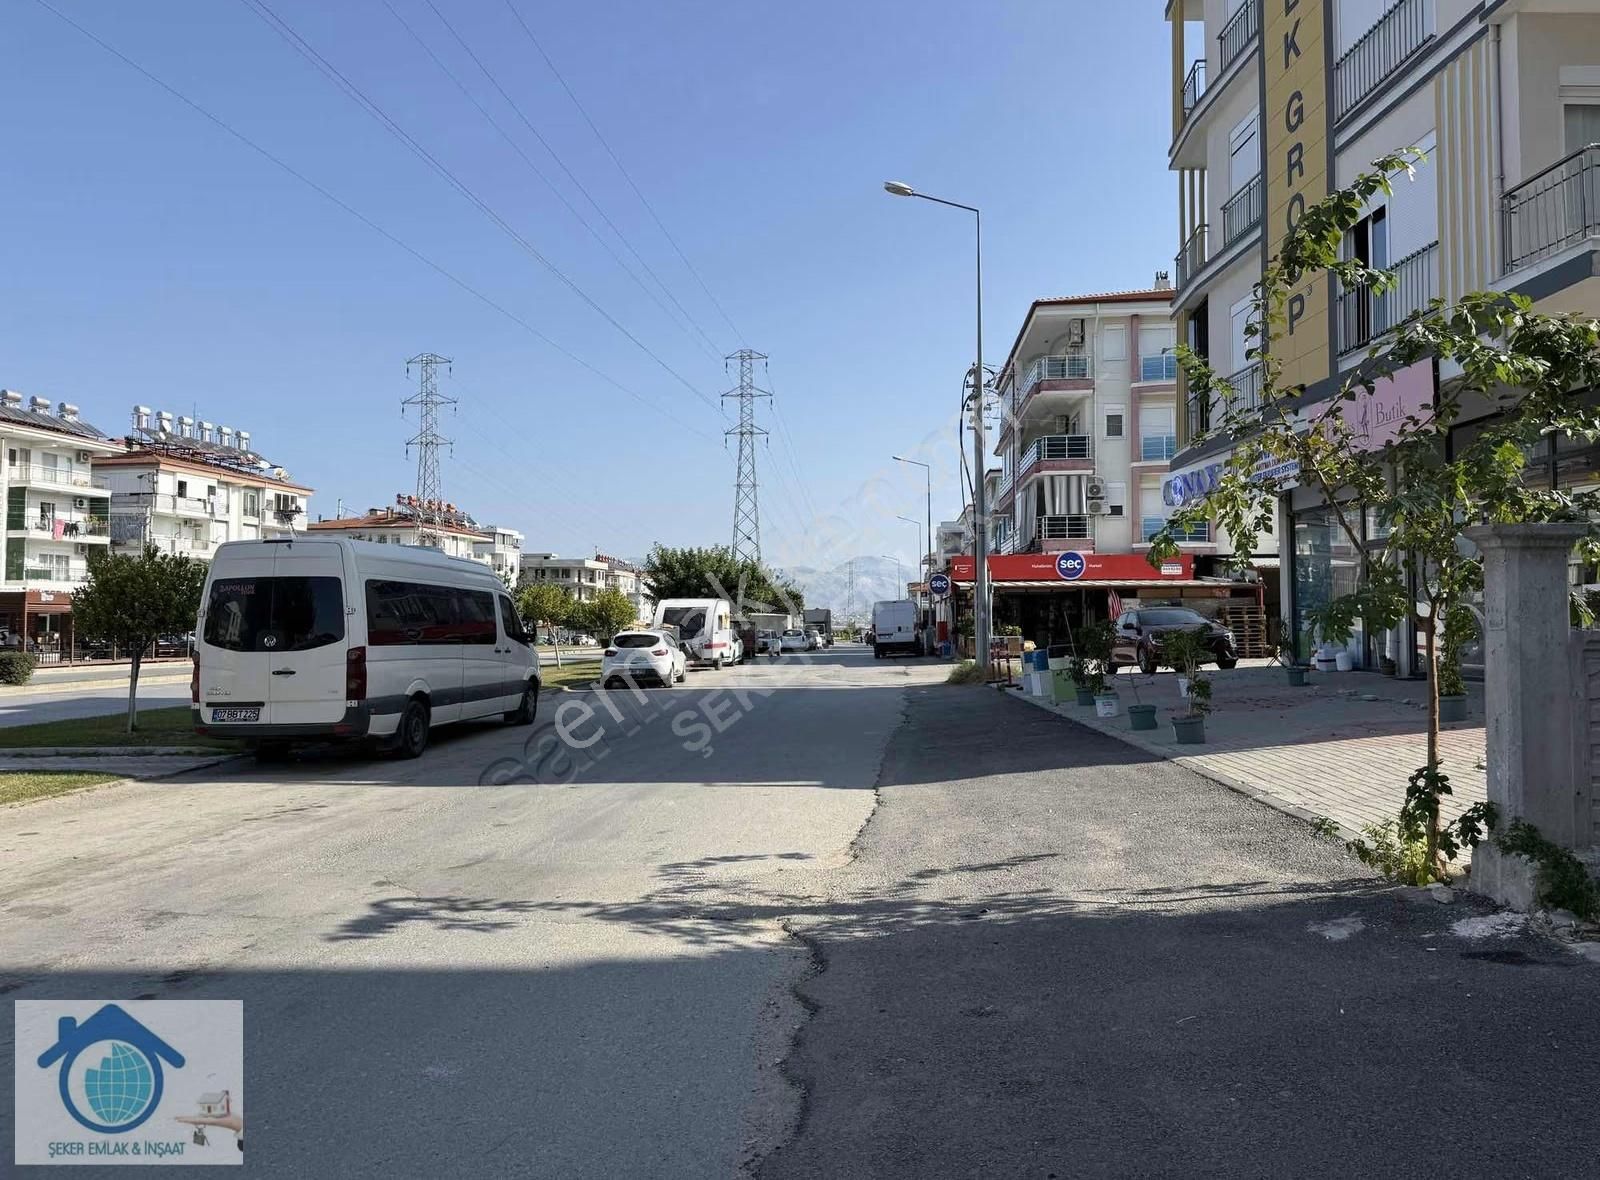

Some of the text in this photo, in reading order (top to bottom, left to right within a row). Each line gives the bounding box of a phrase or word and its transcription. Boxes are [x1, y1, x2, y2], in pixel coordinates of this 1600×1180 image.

[1284, 89, 1305, 336] GROP
[1375, 394, 1407, 425] Butik
[1059, 559, 1082, 571] seç
[931, 580, 947, 588] seç
